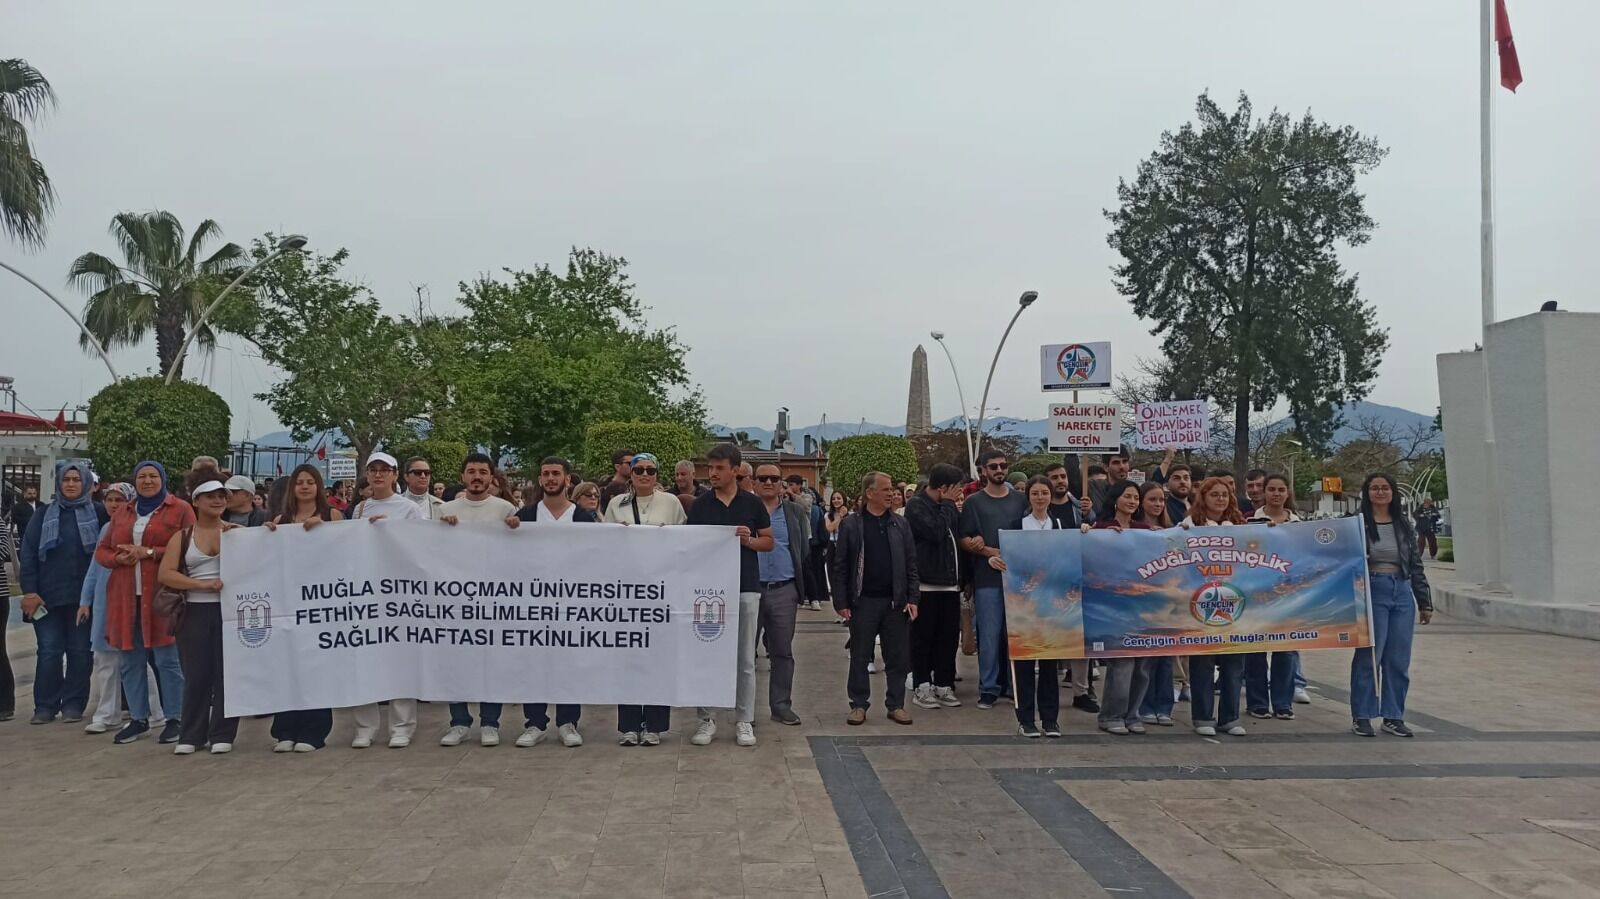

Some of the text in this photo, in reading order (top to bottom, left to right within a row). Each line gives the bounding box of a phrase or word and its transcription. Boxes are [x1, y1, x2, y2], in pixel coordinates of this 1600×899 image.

[1053, 405, 1116, 418] SAĞLIK İÇİN
[1057, 421, 1112, 431] HAREKETE
[1137, 417, 1202, 432] TEDAVİDEN
[1068, 434, 1100, 447] GEÇİN
[1186, 537, 1235, 547] 2026
[1137, 549, 1292, 579] MUĞLA GENÇLİK
[1198, 565, 1233, 576] YILI
[301, 578, 665, 601] MUĞLA SITKI KOÇMAN ÜNİVERSİTESİ
[694, 588, 725, 596] MUĞLA
[236, 592, 271, 601] MUĞLA
[295, 600, 671, 625] FETHİYE SAĞLIK BİLİMLERİ FAKÜLTESİ
[318, 624, 650, 650] SAĞLIK HAFTASI ETKİNLİKLERİ
